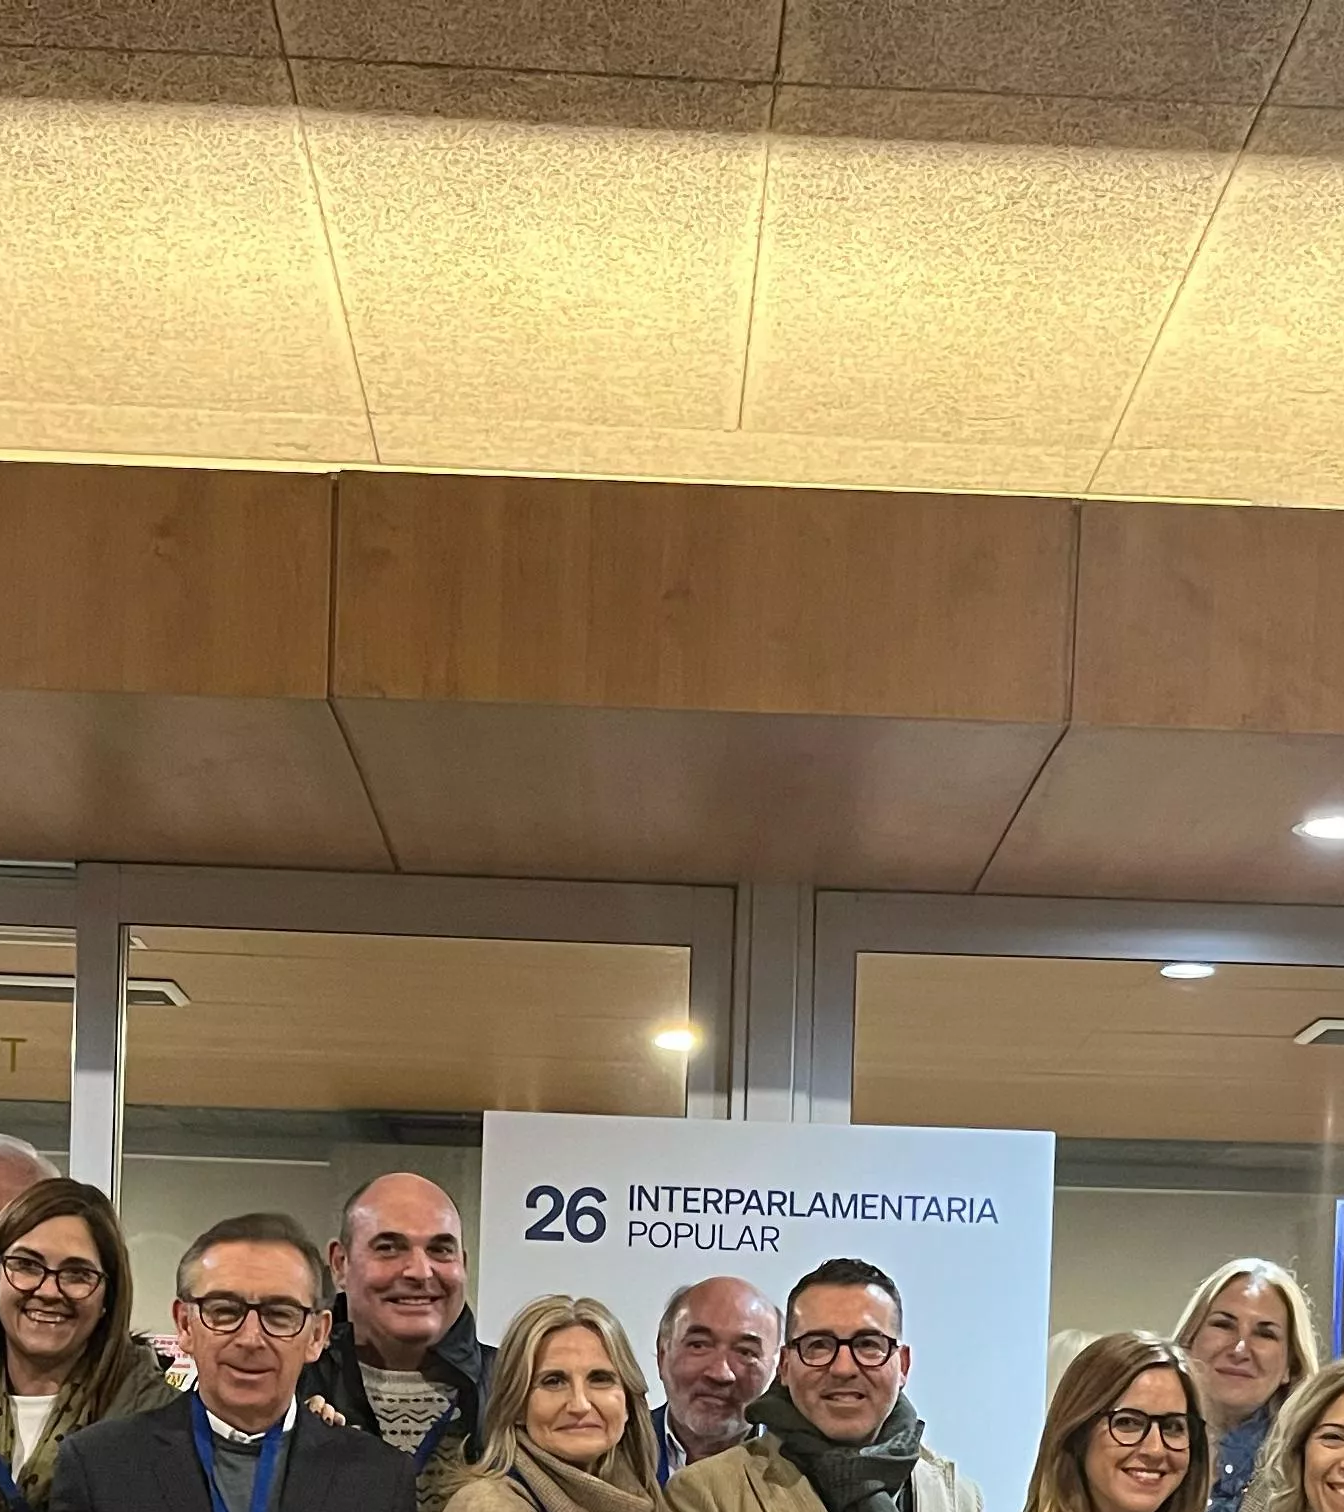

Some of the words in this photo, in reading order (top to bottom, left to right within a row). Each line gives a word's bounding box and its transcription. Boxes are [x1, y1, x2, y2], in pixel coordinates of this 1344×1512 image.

[524, 1184, 608, 1244] 26
[628, 1184, 999, 1225] INTERPARLAMENTARIA
[628, 1220, 780, 1253] POPULAR
